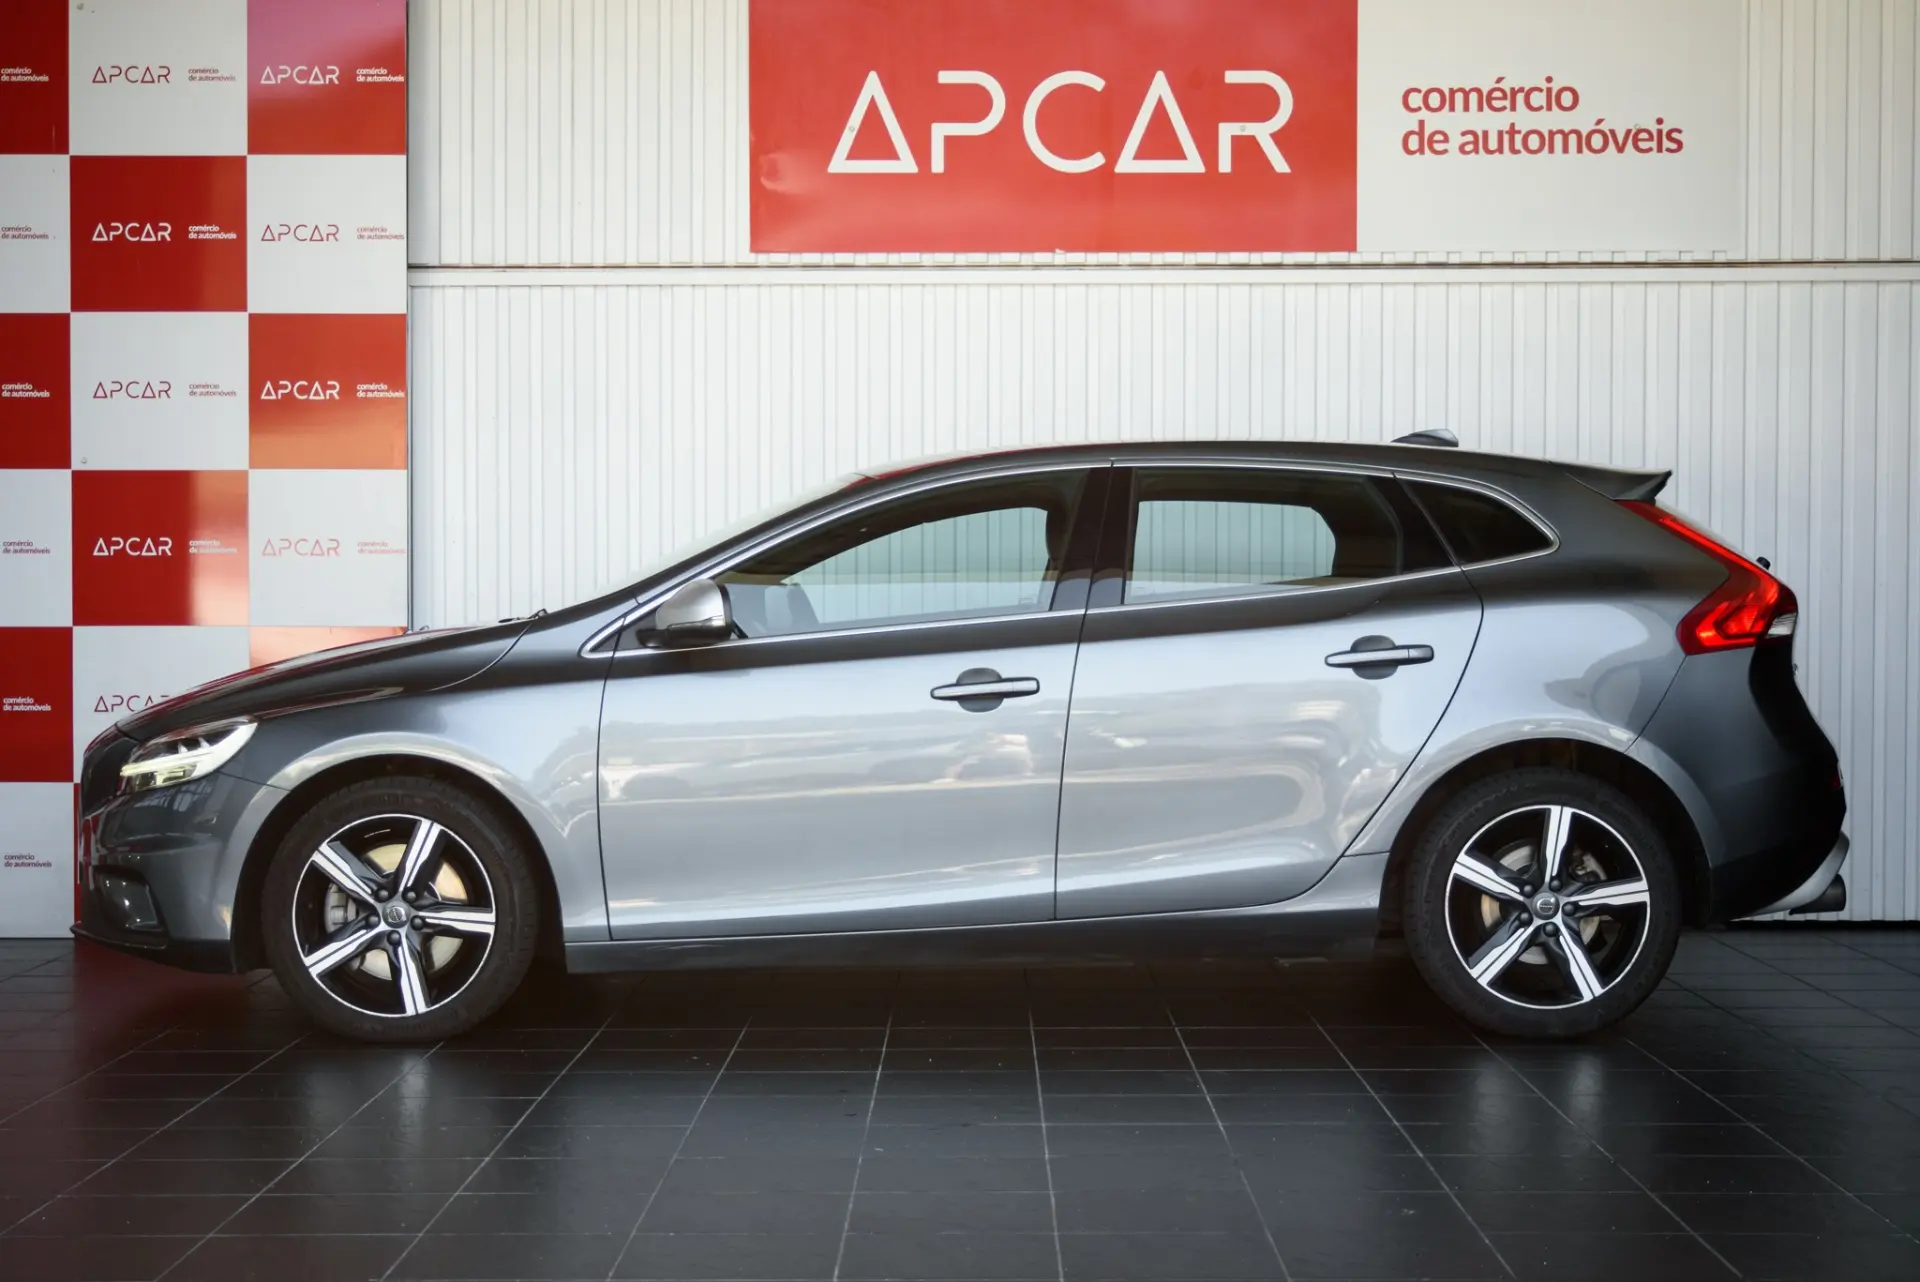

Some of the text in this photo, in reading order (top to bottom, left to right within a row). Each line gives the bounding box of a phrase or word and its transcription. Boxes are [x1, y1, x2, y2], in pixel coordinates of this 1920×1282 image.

[1, 74, 49, 82] de automóveis
[92, 66, 171, 84] APCAR
[260, 65, 340, 85] APCAR
[1402, 76, 1580, 113] comércio
[827, 70, 1293, 174] APCAR
[1402, 117, 1684, 156] de automóveis
[1, 232, 50, 240] de automóveis
[92, 222, 172, 242] APCAR
[261, 224, 340, 242] APCAR
[93, 381, 172, 399] APCAR
[261, 380, 340, 400] APCAR
[357, 390, 405, 398] de automóveis
[3, 547, 51, 555] de automóveis
[93, 537, 172, 556] APCAR
[262, 537, 341, 557] APCAR
[94, 695, 170, 712] APC
